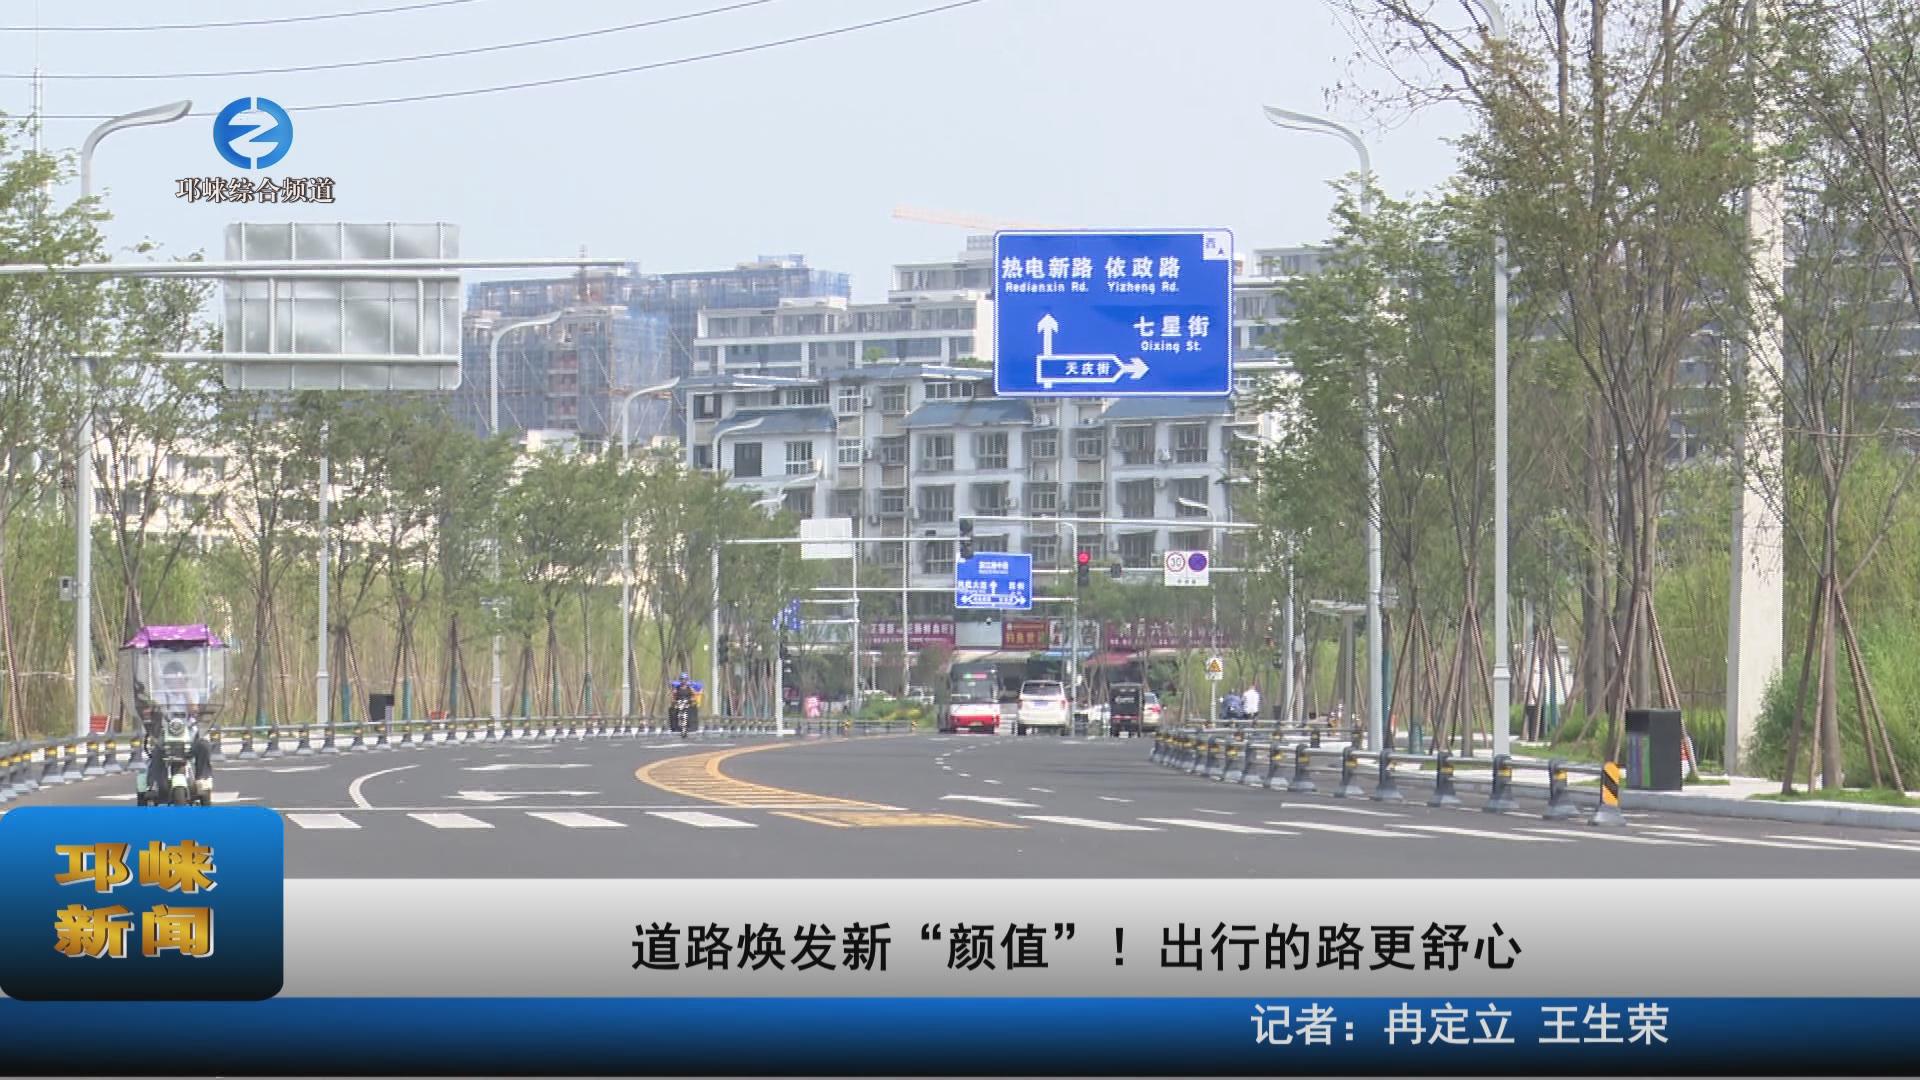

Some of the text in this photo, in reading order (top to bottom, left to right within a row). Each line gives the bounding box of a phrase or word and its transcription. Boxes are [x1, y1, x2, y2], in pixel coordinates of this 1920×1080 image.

[1001, 256, 1181, 279] 热电新路 依政路
[1005, 281, 1089, 292] Redianxin Rd.
[1107, 281, 1155, 294] Yizheng
[1132, 315, 1209, 337] 七星街
[1141, 340, 1180, 353] Qixing
[1065, 361, 1111, 375] 天庆街
